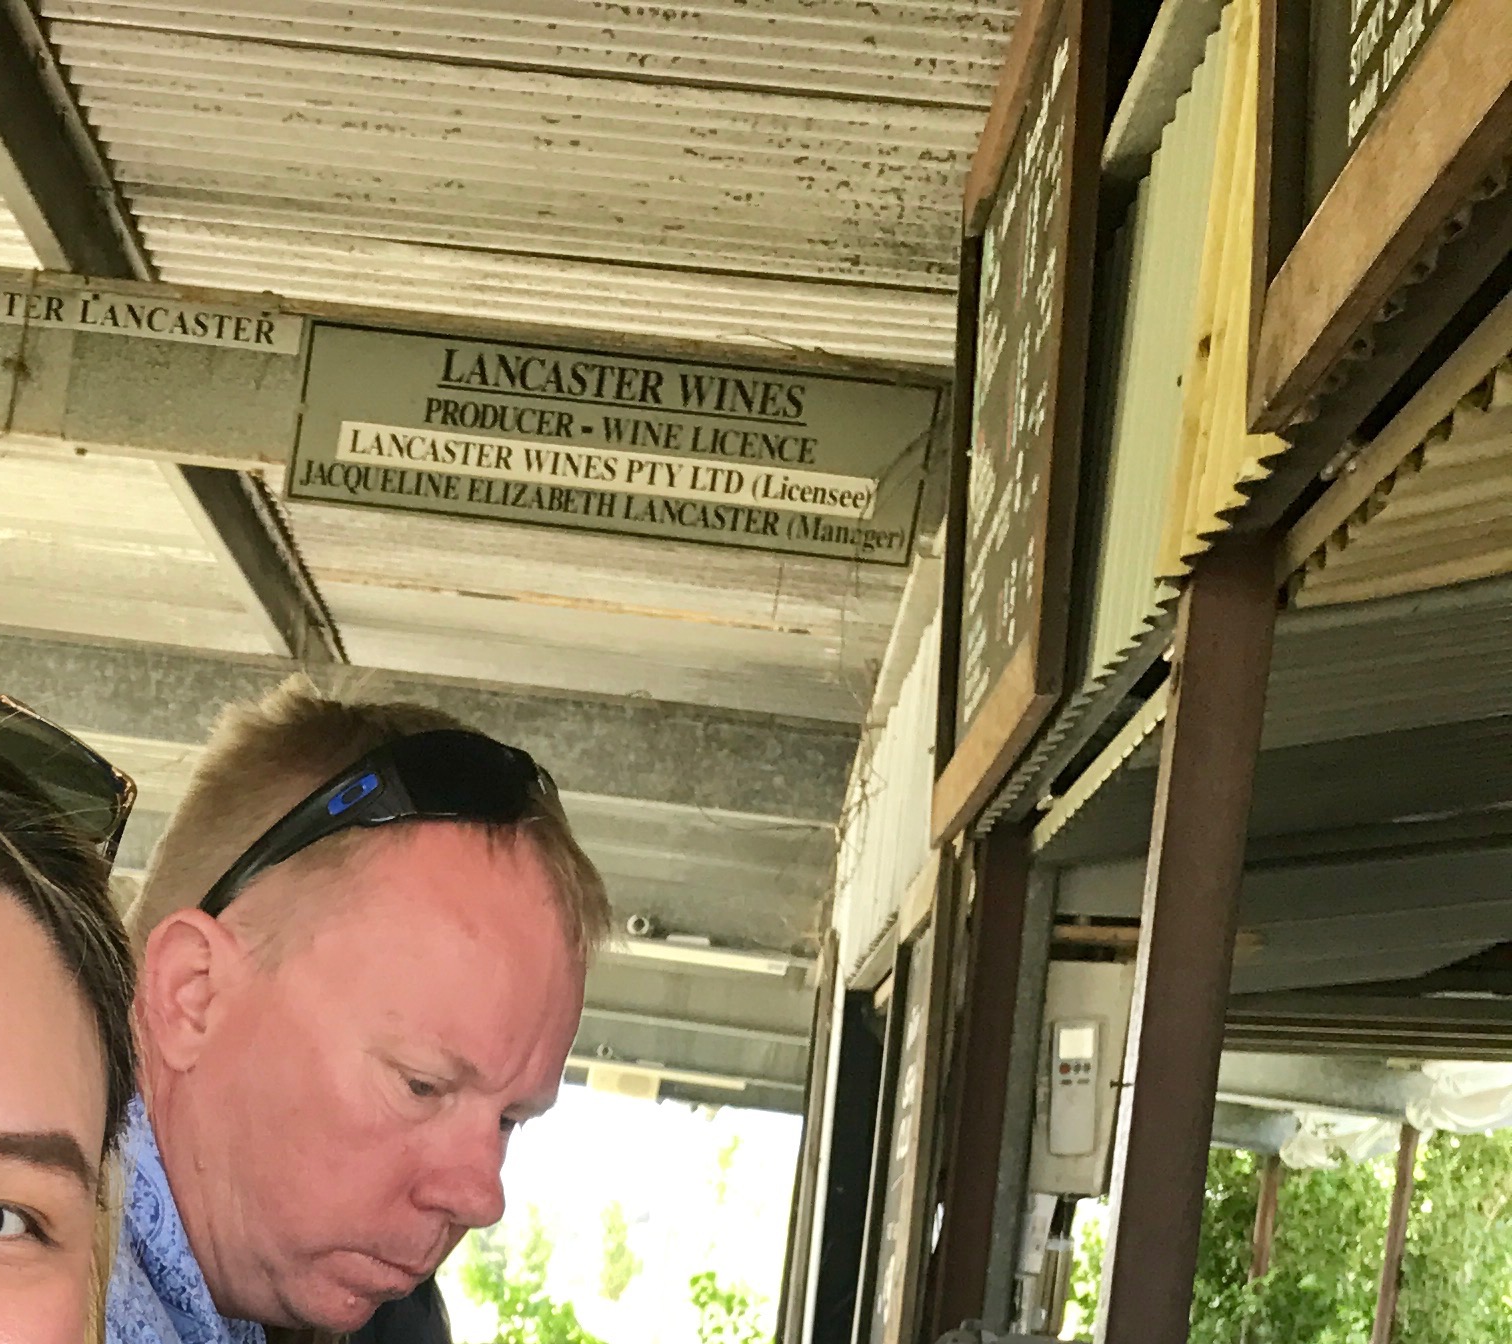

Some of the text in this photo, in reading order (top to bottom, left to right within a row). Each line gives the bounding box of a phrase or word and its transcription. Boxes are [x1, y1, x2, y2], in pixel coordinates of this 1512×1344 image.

[80, 296, 276, 345] LANCASTER
[441, 348, 807, 419] LANCASTER WINES
[423, 397, 575, 438] PRODUCER
[601, 415, 684, 450] WINE
[691, 425, 819, 465] LICENCE
[299, 459, 461, 495] JACQUELINE
[467, 478, 618, 518] ELIZABETH
[624, 493, 780, 537] LANCASTER
[349, 428, 873, 510] LANCASTER WINES PTY LTD (Licensee)
